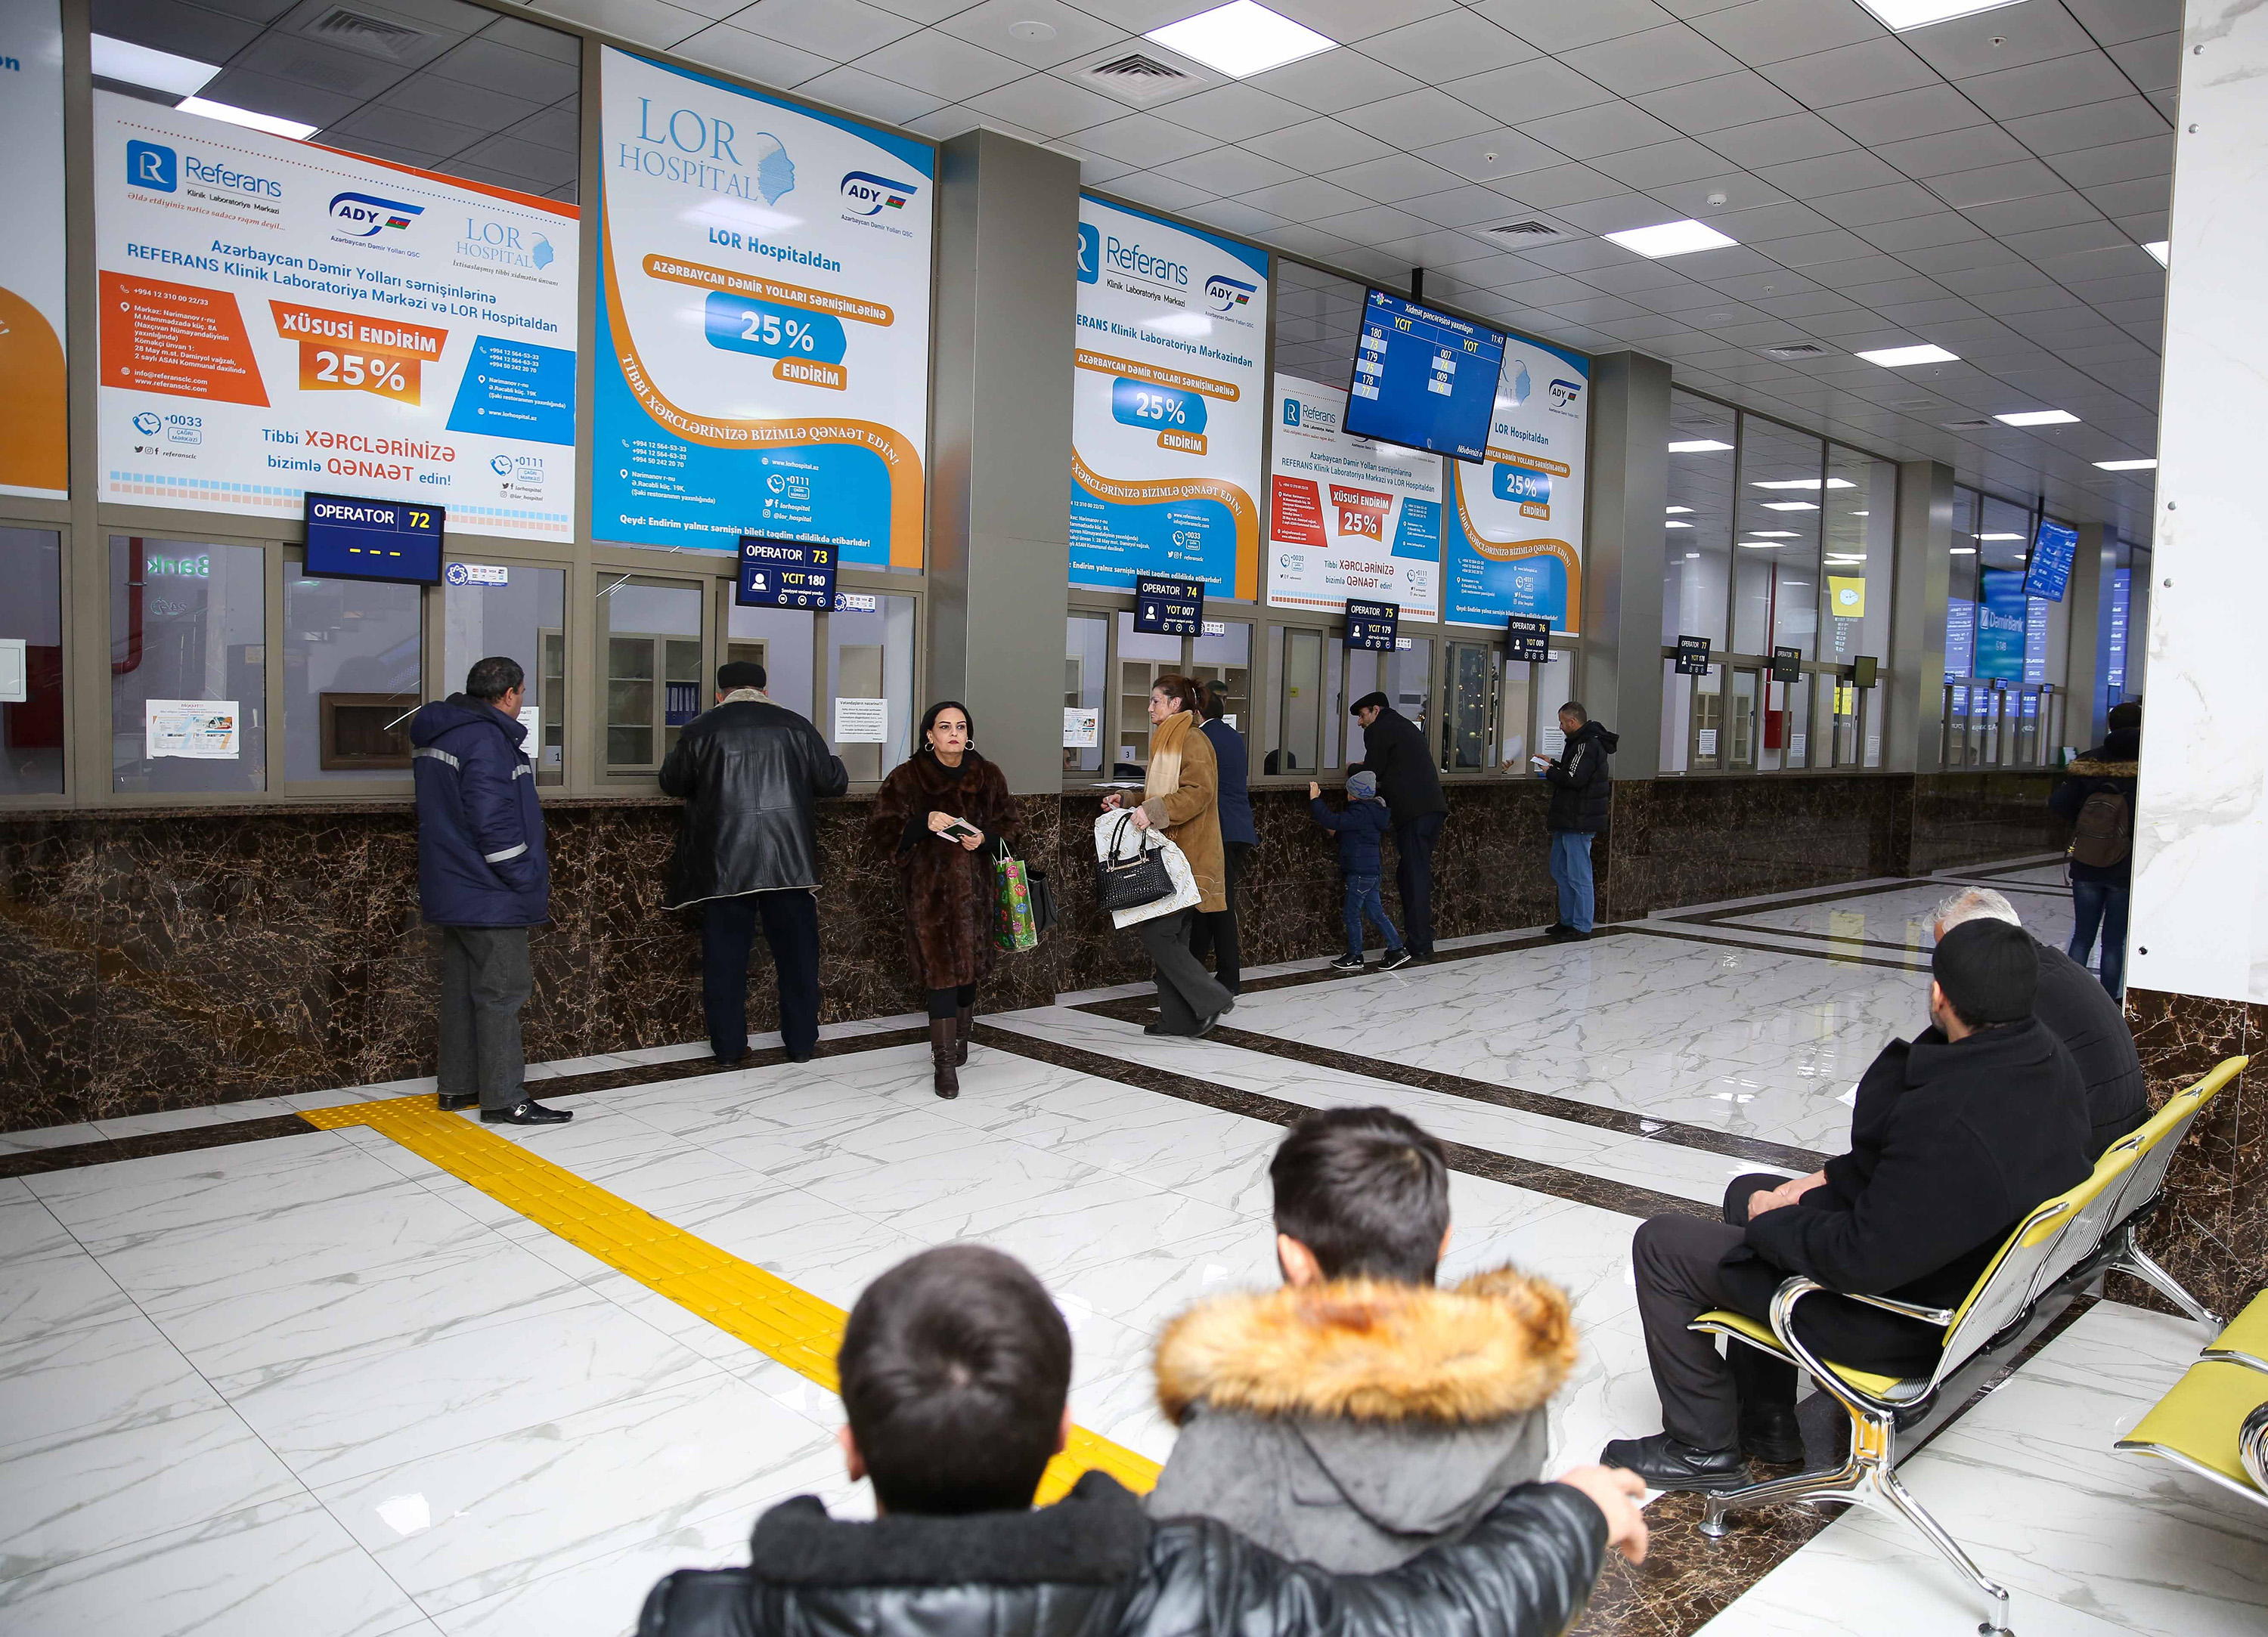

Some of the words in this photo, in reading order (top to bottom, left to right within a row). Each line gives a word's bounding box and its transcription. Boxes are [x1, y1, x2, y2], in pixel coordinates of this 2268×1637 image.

[637, 96, 743, 166] LOR
[186, 156, 282, 198] Referans
[619, 142, 758, 202] HOSPİTAL
[187, 189, 206, 200] Klinik
[209, 193, 251, 209] Laboratoriya
[847, 184, 881, 203] ADY
[128, 192, 147, 202] Əldə
[149, 194, 184, 211] etdiyiniz
[186, 204, 210, 215] nəticə
[211, 209, 236, 220] sadəcə
[237, 215, 260, 227] rəqəm
[338, 206, 380, 224] ADY
[466, 217, 524, 250] LOR
[330, 235, 367, 249] Azərbaycan
[367, 243, 386, 252] Dəmir
[386, 246, 406, 255] Yolları
[456, 240, 533, 269] HOSPİTAL
[708, 227, 742, 249] LOR
[748, 235, 841, 273] Hospitaldan
[1107, 236, 1188, 286] Referans
[212, 240, 303, 269] Azərbaycan
[308, 258, 352, 279] Dəmir
[355, 268, 401, 287] Yolları
[406, 279, 497, 304] sərnişinlərinə
[127, 243, 219, 273] REFERANS
[225, 261, 268, 281] Klinik
[273, 270, 367, 300] Laboratoriya
[371, 289, 428, 310] Mərkəzi
[432, 302, 447, 313] və
[451, 304, 479, 319] LOR
[482, 308, 558, 333] Hospitaldan
[133, 287, 151, 296] +994
[163, 292, 177, 301] 310
[188, 296, 209, 306] 22/33
[652, 260, 725, 286] AZƏRBAYCAN
[727, 274, 763, 293] DƏMİR
[765, 284, 807, 304] YOLLARI
[810, 293, 886, 318] SƏRNİŞİNLƏRİNƏ
[1106, 278, 1123, 291] Klinik
[1126, 283, 1161, 302] Laboratoriya
[1163, 295, 1185, 308] Mərkəzi
[1210, 286, 1232, 300] ADY
[134, 305, 162, 315] Mərkəz:
[163, 309, 200, 322] Nərimanov
[1405, 303, 1423, 317] Xidmət
[282, 311, 354, 340] XÜSUSİ
[360, 326, 438, 354] ENDİRİM
[741, 308, 815, 351] 25%
[1370, 326, 1382, 339] 180
[1393, 316, 1412, 333] YCIT
[1111, 323, 1138, 340] Klinik
[1140, 330, 1197, 354] Laboratoriya
[1199, 345, 1253, 368] Mərkəzindən
[1369, 339, 1378, 350] 73
[1462, 339, 1479, 353] YOT
[1491, 333, 1504, 345] 11:47
[1366, 350, 1378, 362] 179
[1440, 348, 1452, 361] 007
[315, 350, 406, 392] 25%
[782, 362, 839, 387] ENDİRİM
[1078, 353, 1126, 373] AZƏRBAYCAN
[1127, 365, 1151, 379] DƏMİR
[1152, 370, 1181, 384] YOLLARI
[1182, 376, 1235, 396] SƏRNİŞİNLƏRİNƏ
[1365, 362, 1374, 373] 75
[1439, 360, 1448, 370] 74
[134, 369, 208, 385] info@referansclc.com
[135, 379, 207, 392] www.referansclc.com
[1362, 374, 1374, 385] 178
[1436, 371, 1448, 382] 009
[1361, 386, 1370, 397] 77
[1436, 382, 1445, 393] 76
[622, 354, 651, 398] TİBBİ
[646, 394, 748, 441] XƏRCLƏRİNİZƏ
[751, 426, 807, 441] BİZİMLƏ
[809, 426, 863, 442] QƏNAƏT
[866, 432, 900, 466] EDİN!
[1136, 391, 1186, 425] 25%
[1302, 404, 1337, 424] Referans
[1163, 433, 1203, 452] ENDİRİM
[1494, 422, 1509, 436] LOR
[1510, 425, 1549, 446] Hospitaldan
[262, 428, 299, 445] Tibbi
[305, 429, 456, 463] XƏRCLƏRİNİZƏ
[267, 455, 322, 472] bizimlə
[327, 456, 415, 482] QƏNAƏT
[419, 471, 452, 486] edin!
[772, 459, 819, 471] www.lorhospital.az
[1072, 463, 1141, 499] XƏRCLƏRİNİZƏ
[1142, 486, 1179, 499] BİZİMLƏ
[1181, 485, 1219, 500] QƏNAƏT
[1220, 490, 1244, 517] EDİN!
[1506, 473, 1538, 499] 25%
[1333, 490, 1359, 505] XÜSUSİ
[1360, 494, 1389, 509] ENDİRİM
[313, 503, 395, 525] OPERATOR
[408, 511, 430, 529] 72
[1523, 504, 1548, 519] ENDİRİM
[620, 514, 646, 527] Qeyd:
[648, 518, 681, 530] Endirim
[683, 521, 709, 533] yalnız
[711, 526, 742, 537] sərnişin
[744, 527, 764, 537] bileti
[766, 530, 794, 542] təqdim
[795, 532, 830, 545] edildikdə
[831, 535, 870, 548] etibarlıdır!
[1344, 513, 1377, 534] 25%
[746, 545, 803, 561] OPERATOR
[812, 549, 829, 564] 73
[1324, 559, 1338, 570] Tibbi
[1339, 559, 1395, 575] XƏRCLƏRİNİZƏ
[781, 572, 806, 584] YCIT
[807, 574, 826, 586] 180
[1325, 575, 1346, 585] bizimlə
[1346, 576, 1379, 589] QƏNAƏT
[1380, 581, 1393, 590] edin!
[1142, 583, 1180, 596] OPERATOR
[1186, 586, 1198, 598] 74
[1166, 604, 1181, 614] YOT
[1182, 606, 1194, 616] 007
[1350, 605, 1380, 616] OPERATOR
[1385, 608, 1394, 618] 75
[1368, 624, 1380, 633] YCIT
[1381, 625, 1392, 634] 179
[1512, 621, 1536, 631] OPERATOR
[1538, 624, 1546, 633] 76
[1526, 638, 1535, 646] YOT
[1535, 639, 1545, 648] 009
[1681, 640, 1699, 648] OPERATOR
[1701, 641, 1707, 650] 77
[1777, 650, 1792, 658] OPERATOR
[1125, 750, 1130, 759] 3
